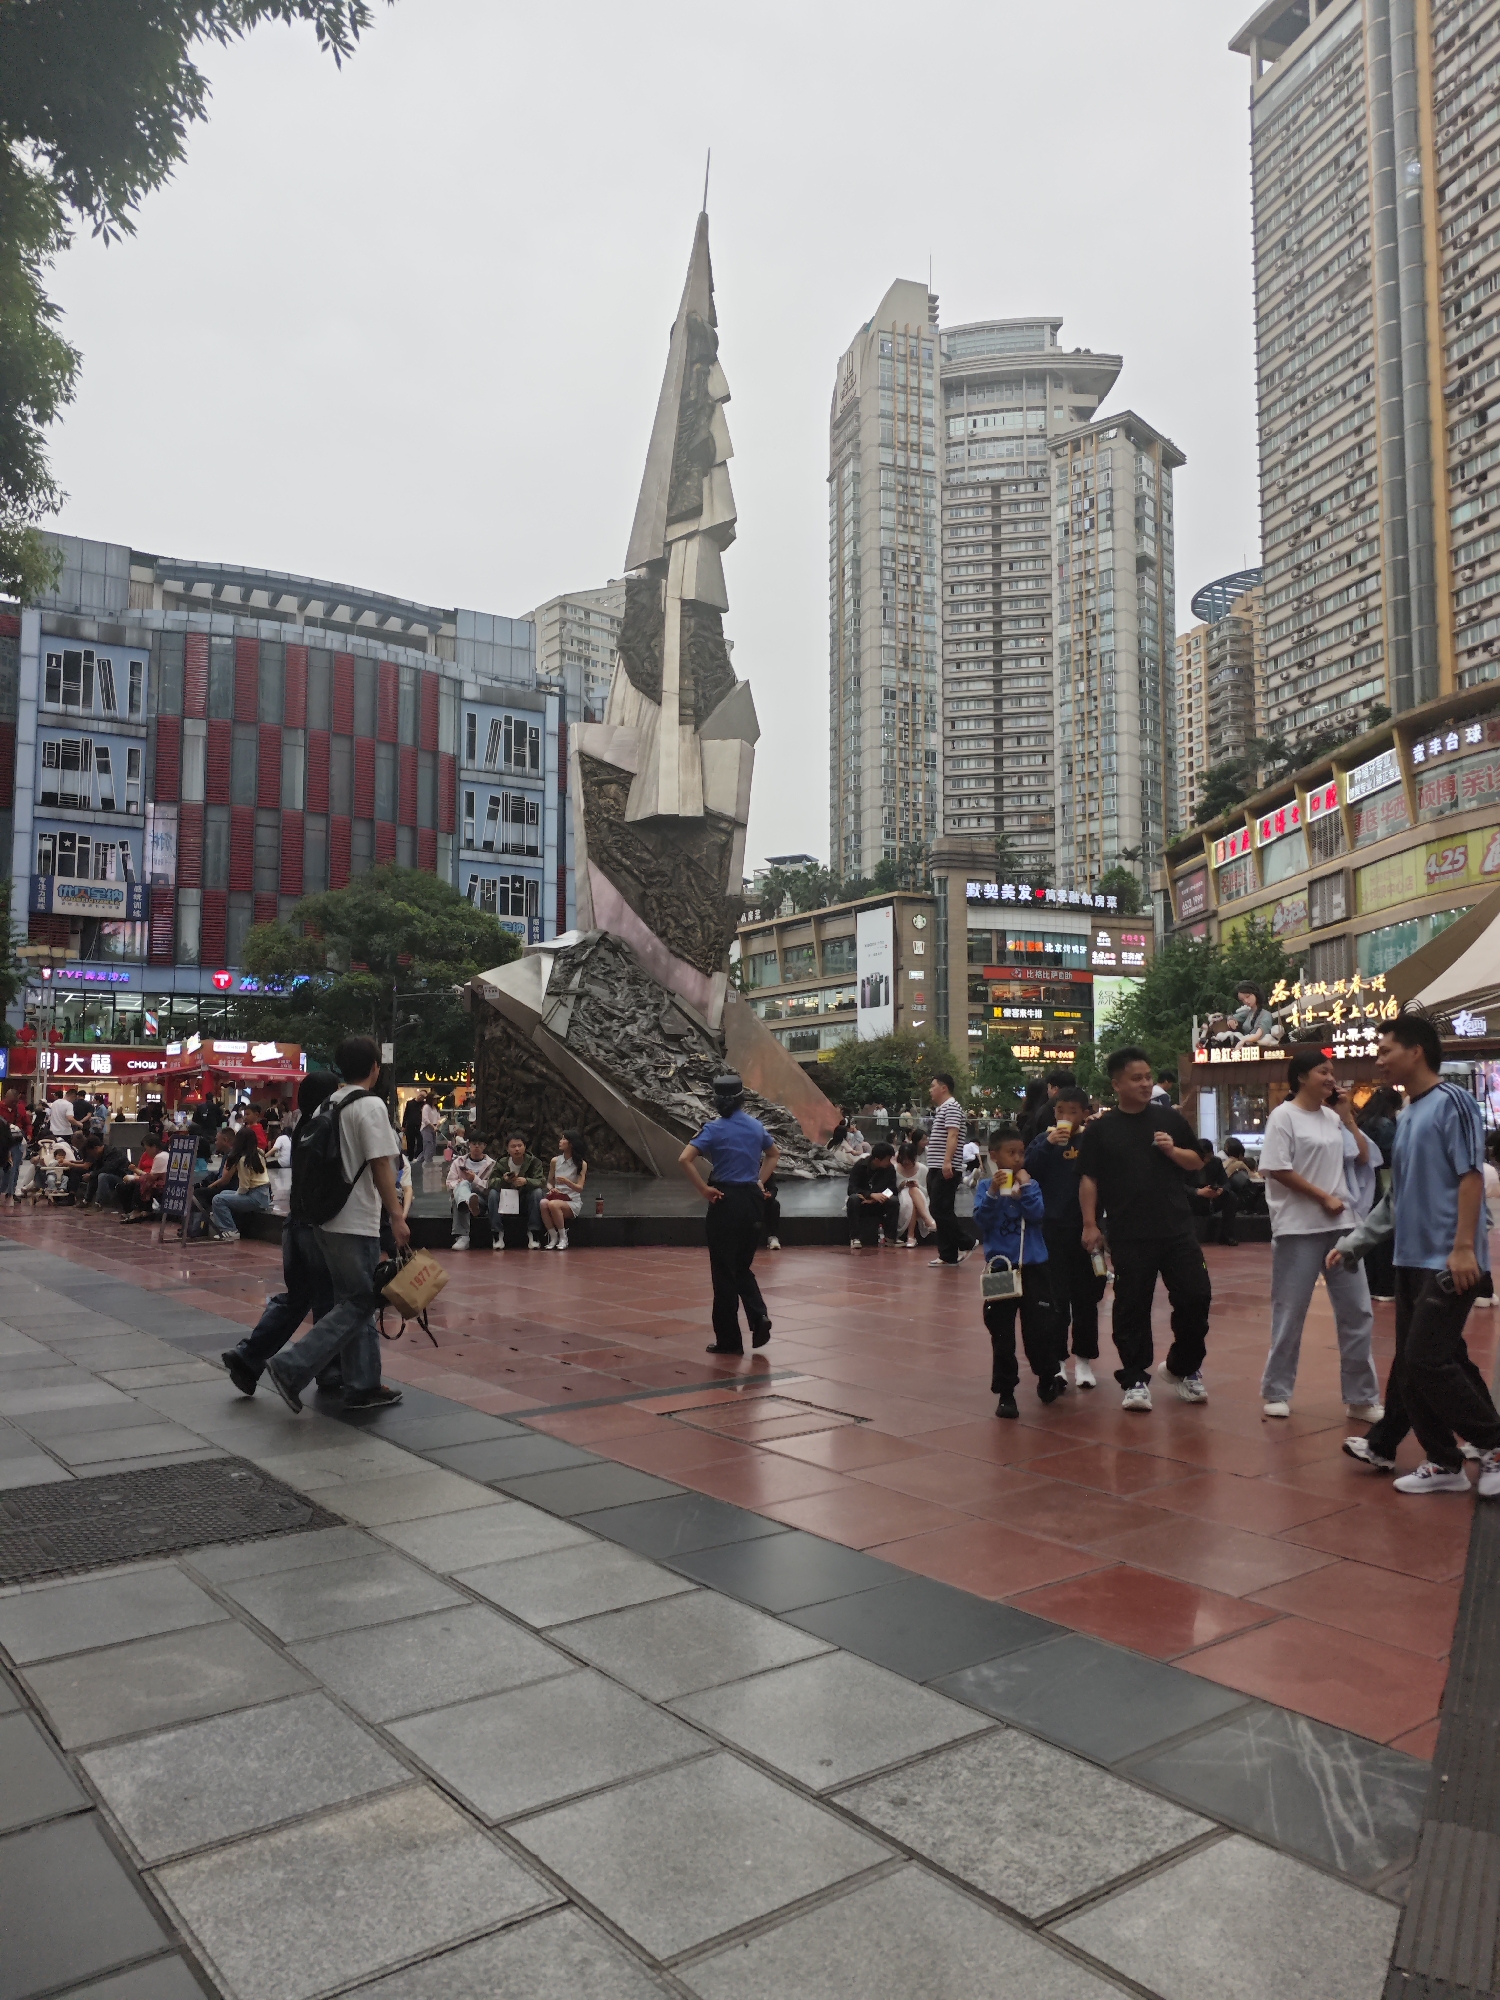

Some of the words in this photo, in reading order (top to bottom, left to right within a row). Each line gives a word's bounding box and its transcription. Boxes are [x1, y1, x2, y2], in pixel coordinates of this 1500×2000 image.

[1412, 723, 1483, 764] 竞丰台球
[965, 882, 1033, 901] 默契美发
[57, 969, 83, 980] TYF
[1026, 969, 1073, 980] 比格比萨自助
[1332, 1026, 1384, 1042] 山果茶
[40, 1052, 113, 1074] 周大福
[126, 1060, 158, 1070] CHOW
[409, 1265, 431, 1291] 1977
